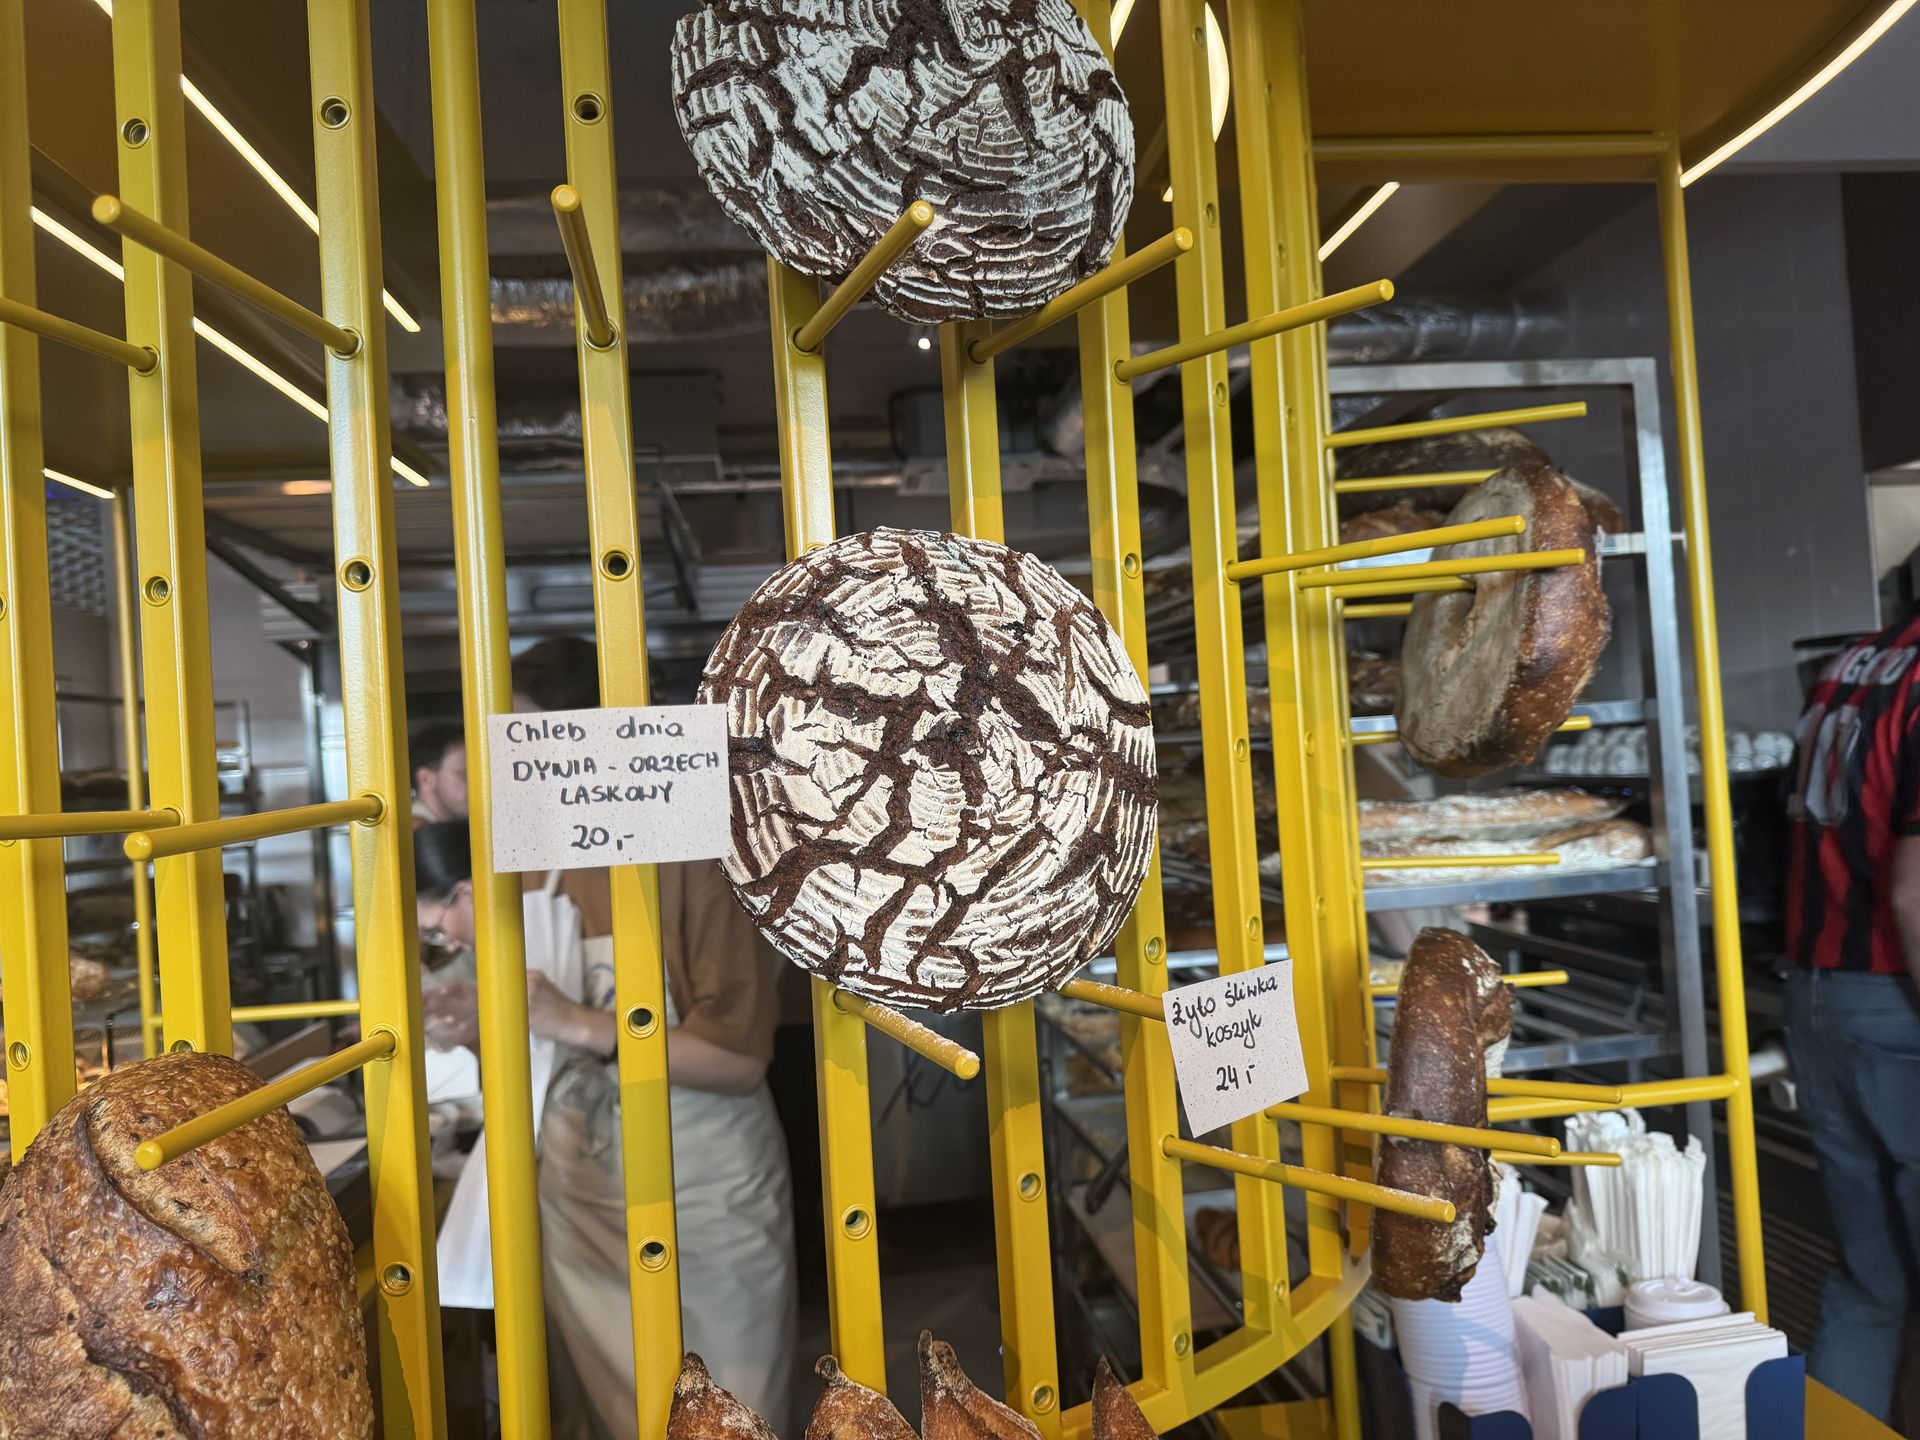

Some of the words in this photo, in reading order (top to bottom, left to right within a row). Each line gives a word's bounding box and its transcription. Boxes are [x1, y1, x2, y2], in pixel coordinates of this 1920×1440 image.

[506, 720, 587, 743] Chleb
[616, 715, 684, 739] dnia
[512, 757, 597, 781] DYNIA
[629, 752, 719, 773] ORZECH
[560, 781, 673, 805] LASKOWY
[1205, 1009, 1262, 1049] koszyk
